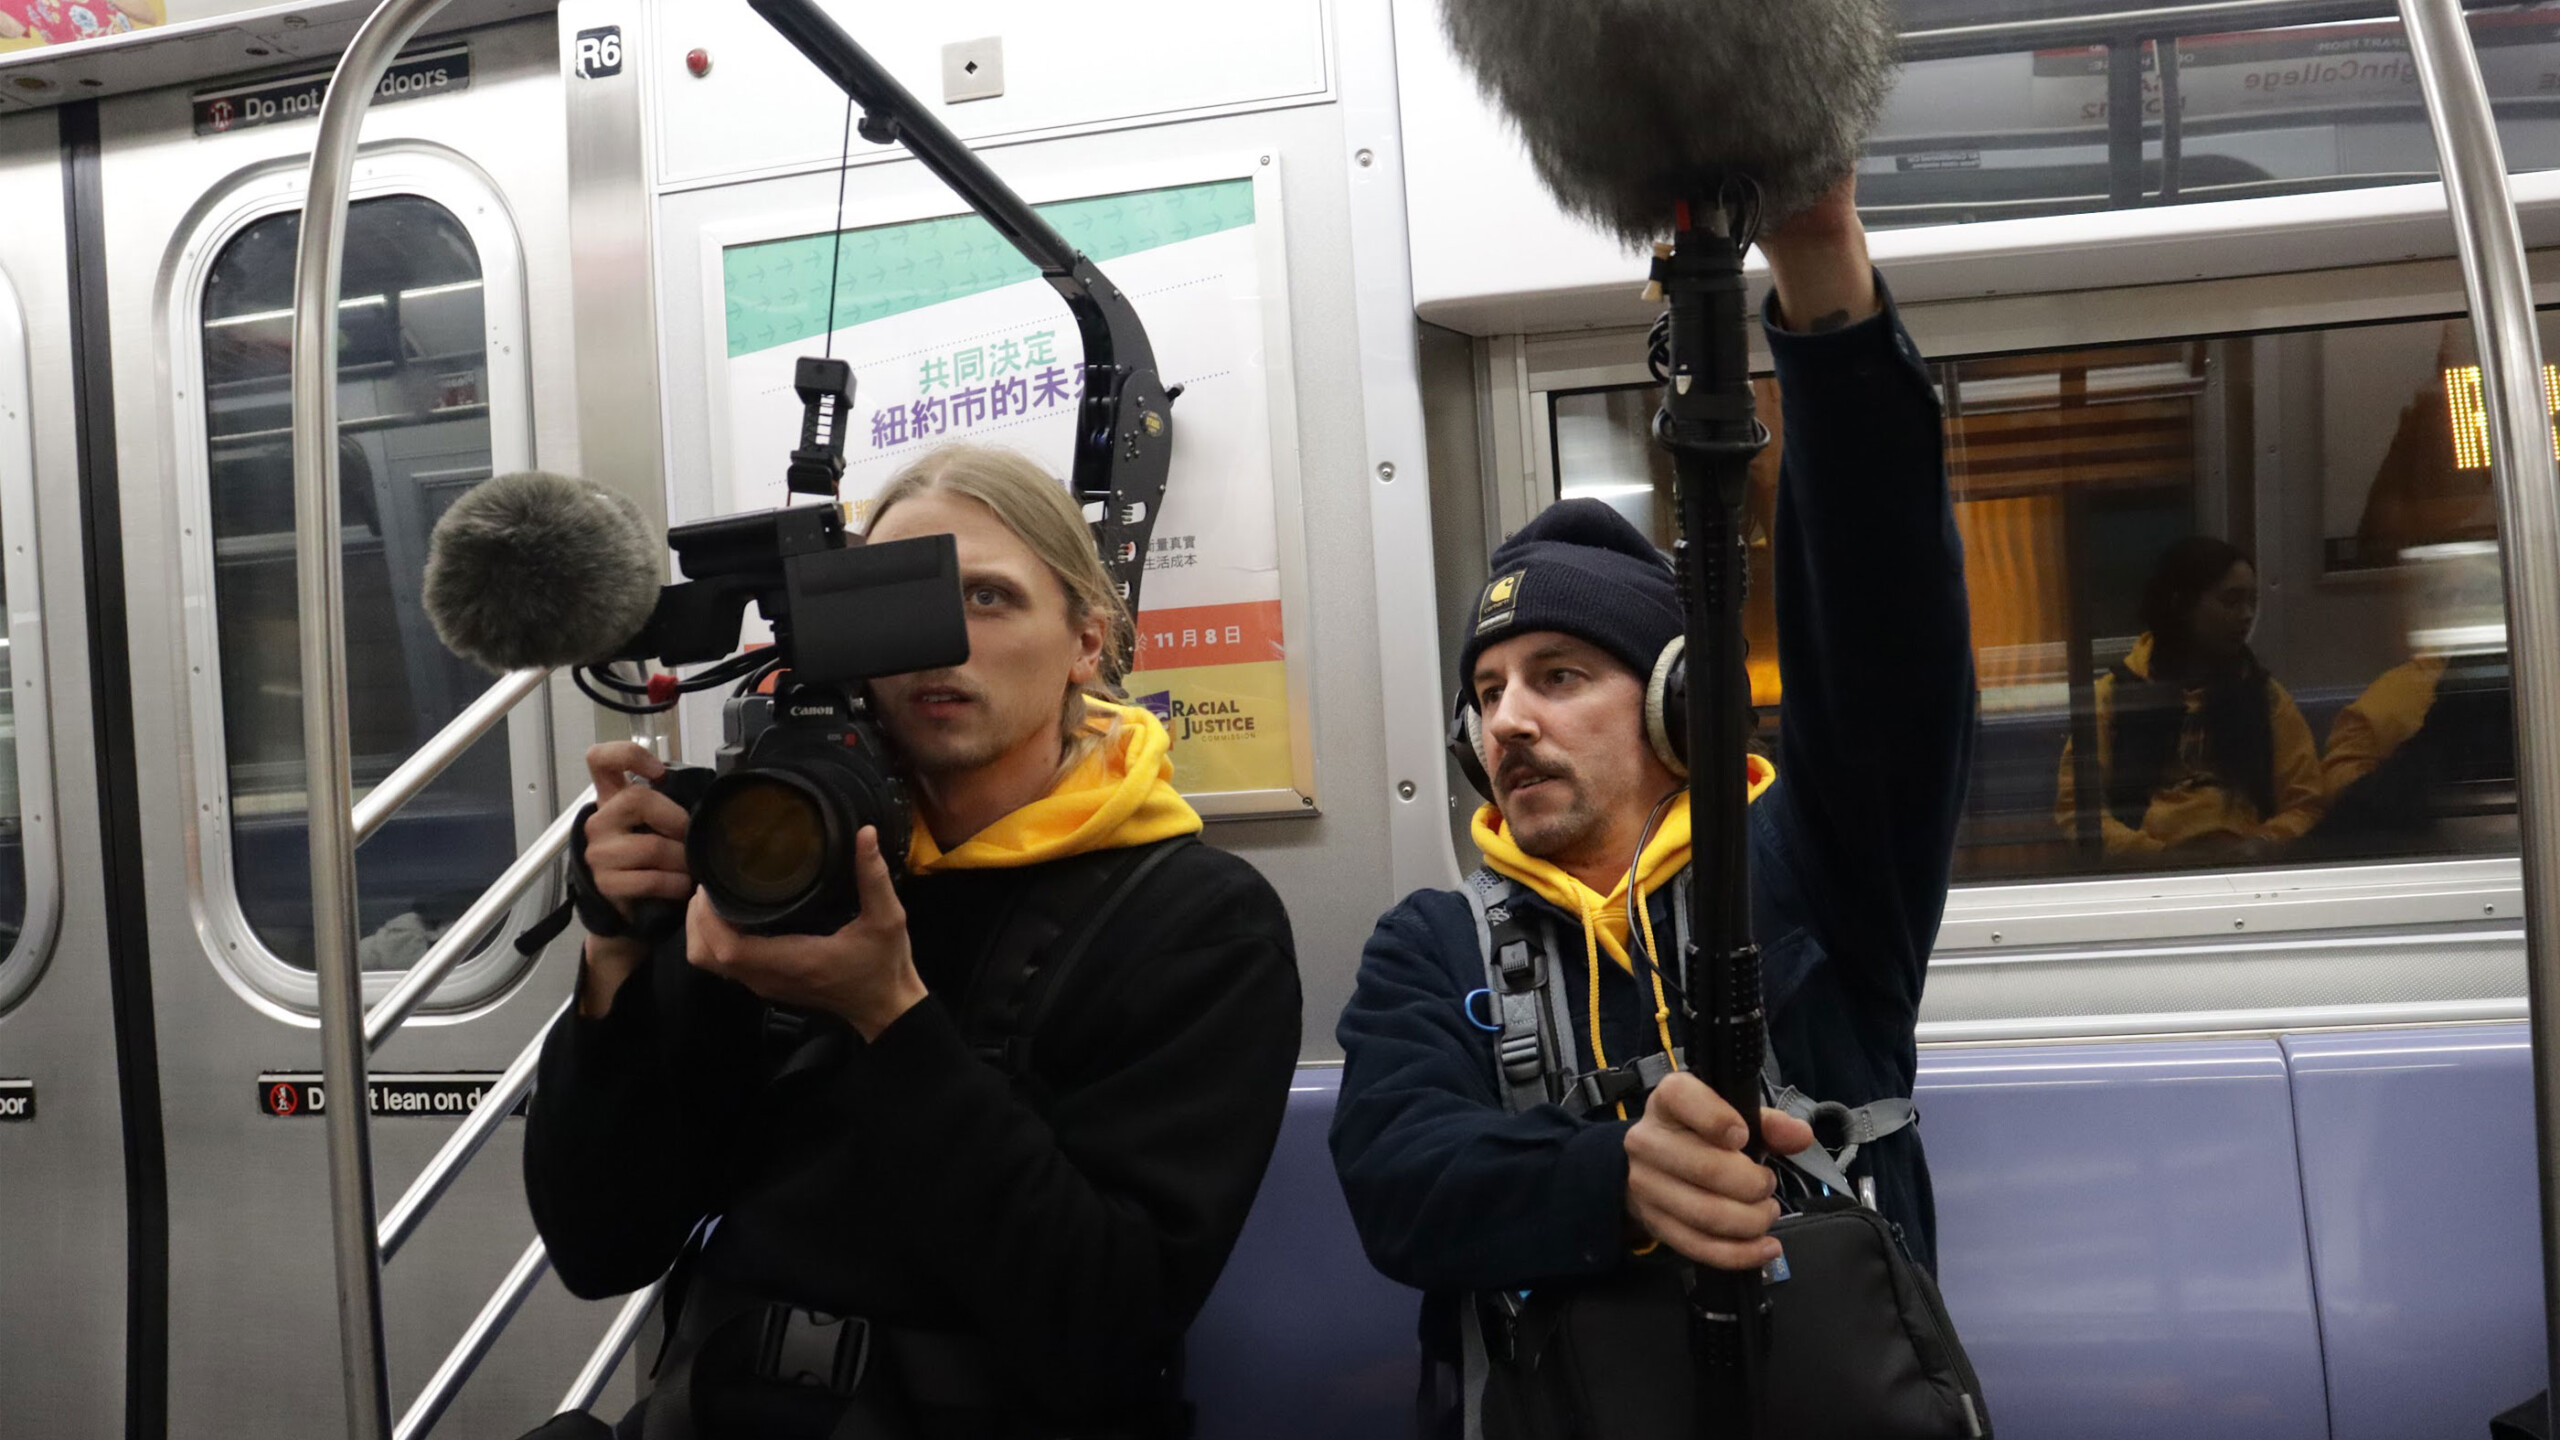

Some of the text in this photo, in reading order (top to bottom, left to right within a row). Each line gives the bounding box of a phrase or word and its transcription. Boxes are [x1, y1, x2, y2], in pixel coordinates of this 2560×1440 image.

[577, 34, 620, 70] R6
[245, 98, 275, 121] Do
[282, 88, 320, 115] not
[381, 68, 449, 97] doors
[919, 330, 1057, 394] 共同決定
[1143, 553, 1198, 571] 生活成本
[790, 706, 833, 716] Canon
[1171, 700, 1240, 718] RACIAL
[1181, 717, 1255, 740] JUSTICE
[1202, 733, 1256, 742] COMMISSION
[308, 1087, 325, 1110] D
[383, 1087, 429, 1111] lean
[434, 1091, 463, 1111] on
